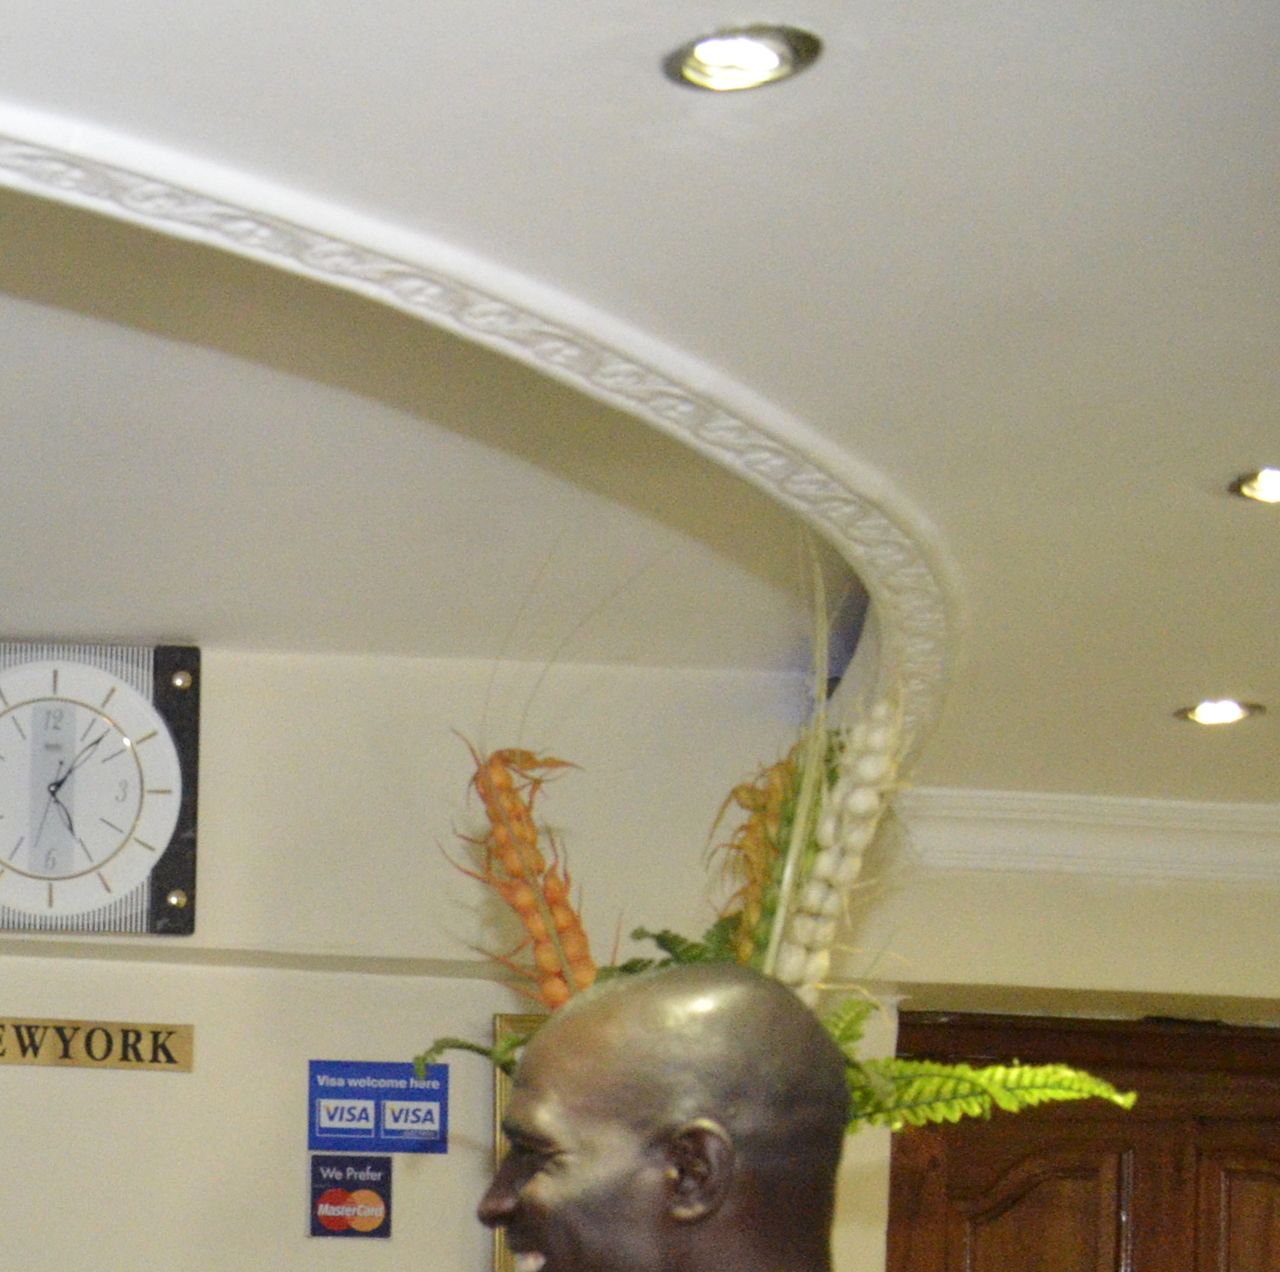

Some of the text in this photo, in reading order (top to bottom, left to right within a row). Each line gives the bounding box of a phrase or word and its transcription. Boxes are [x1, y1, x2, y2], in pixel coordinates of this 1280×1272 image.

[44, 709, 64, 731] 12
[115, 779, 128, 802] 3
[44, 848, 56, 871] 6
[317, 1075, 440, 1090] Visa welcome here
[326, 1104, 370, 1122] VISA
[391, 1107, 435, 1124] VISA
[320, 1166, 383, 1181] We Prefer
[317, 1204, 385, 1217] MasterCard
